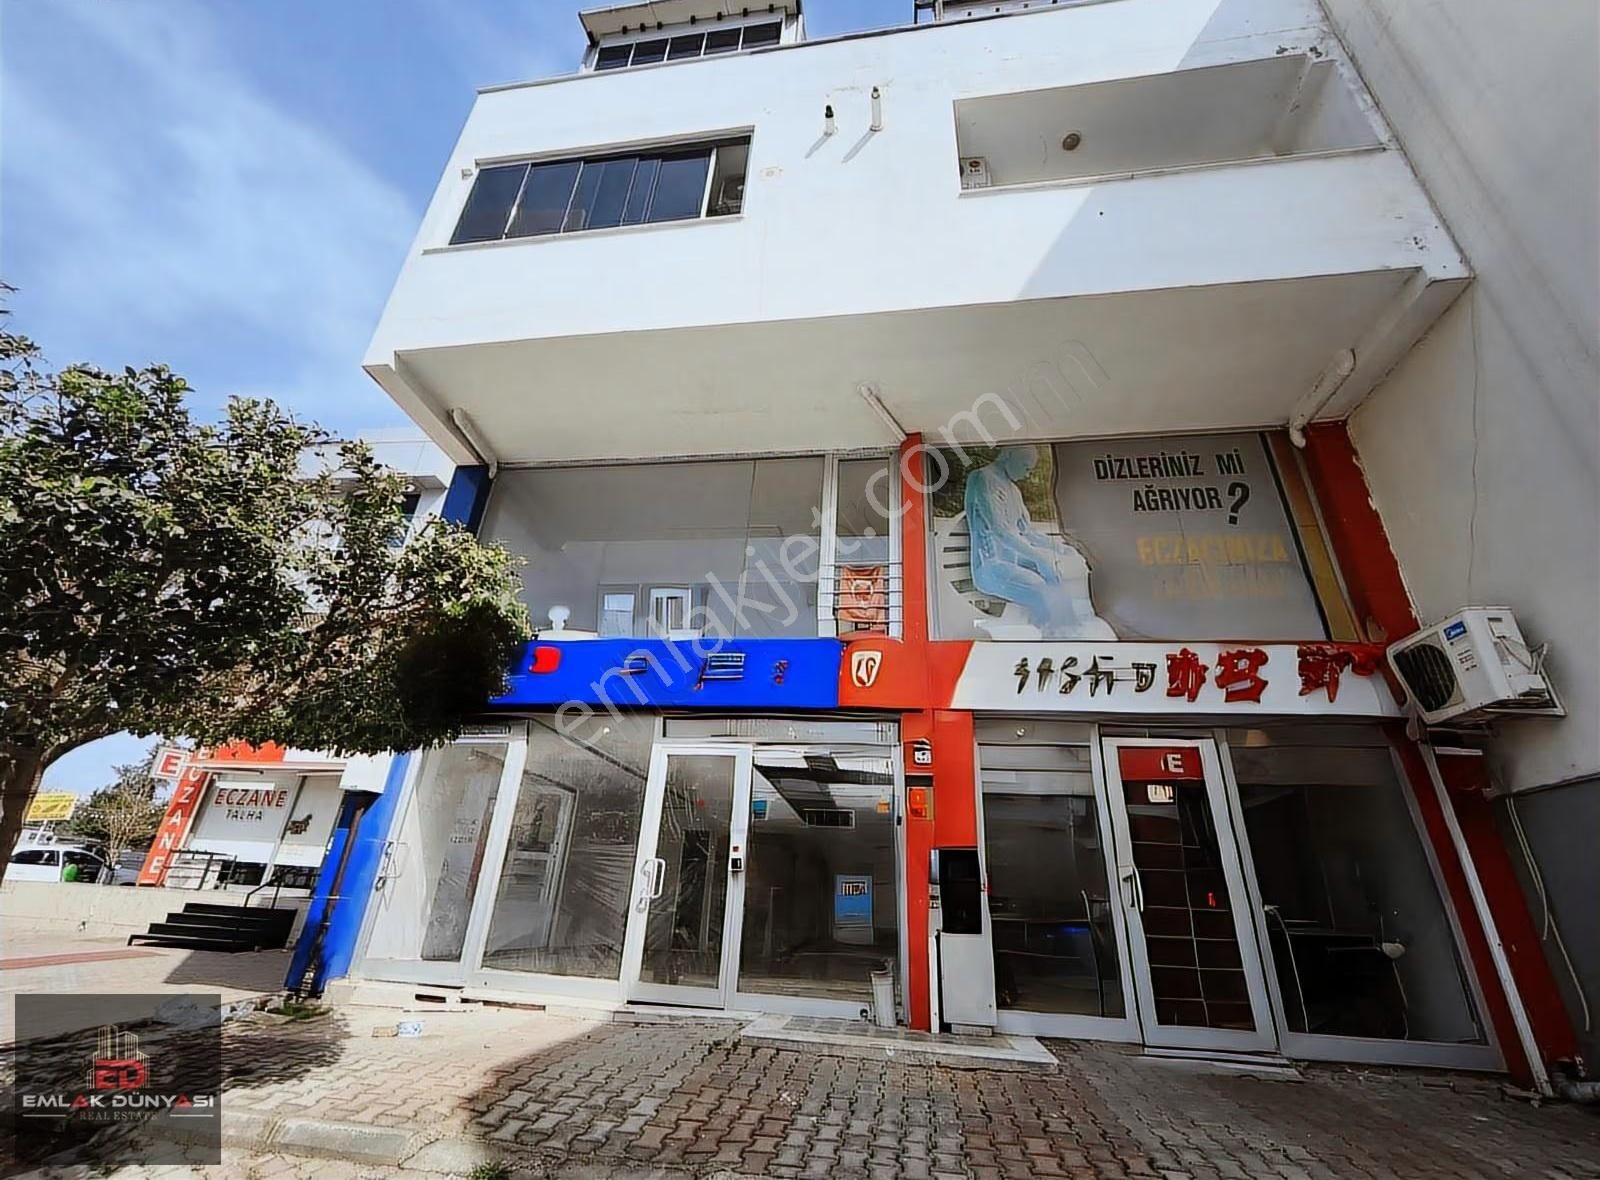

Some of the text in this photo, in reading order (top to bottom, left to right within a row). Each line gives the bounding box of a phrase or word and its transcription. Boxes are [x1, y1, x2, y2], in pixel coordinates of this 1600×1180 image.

[1093, 448, 1245, 480] DİZLERİNİZ Mİ
[160, 754, 182, 776] E
[214, 787, 288, 808] ECZANE
